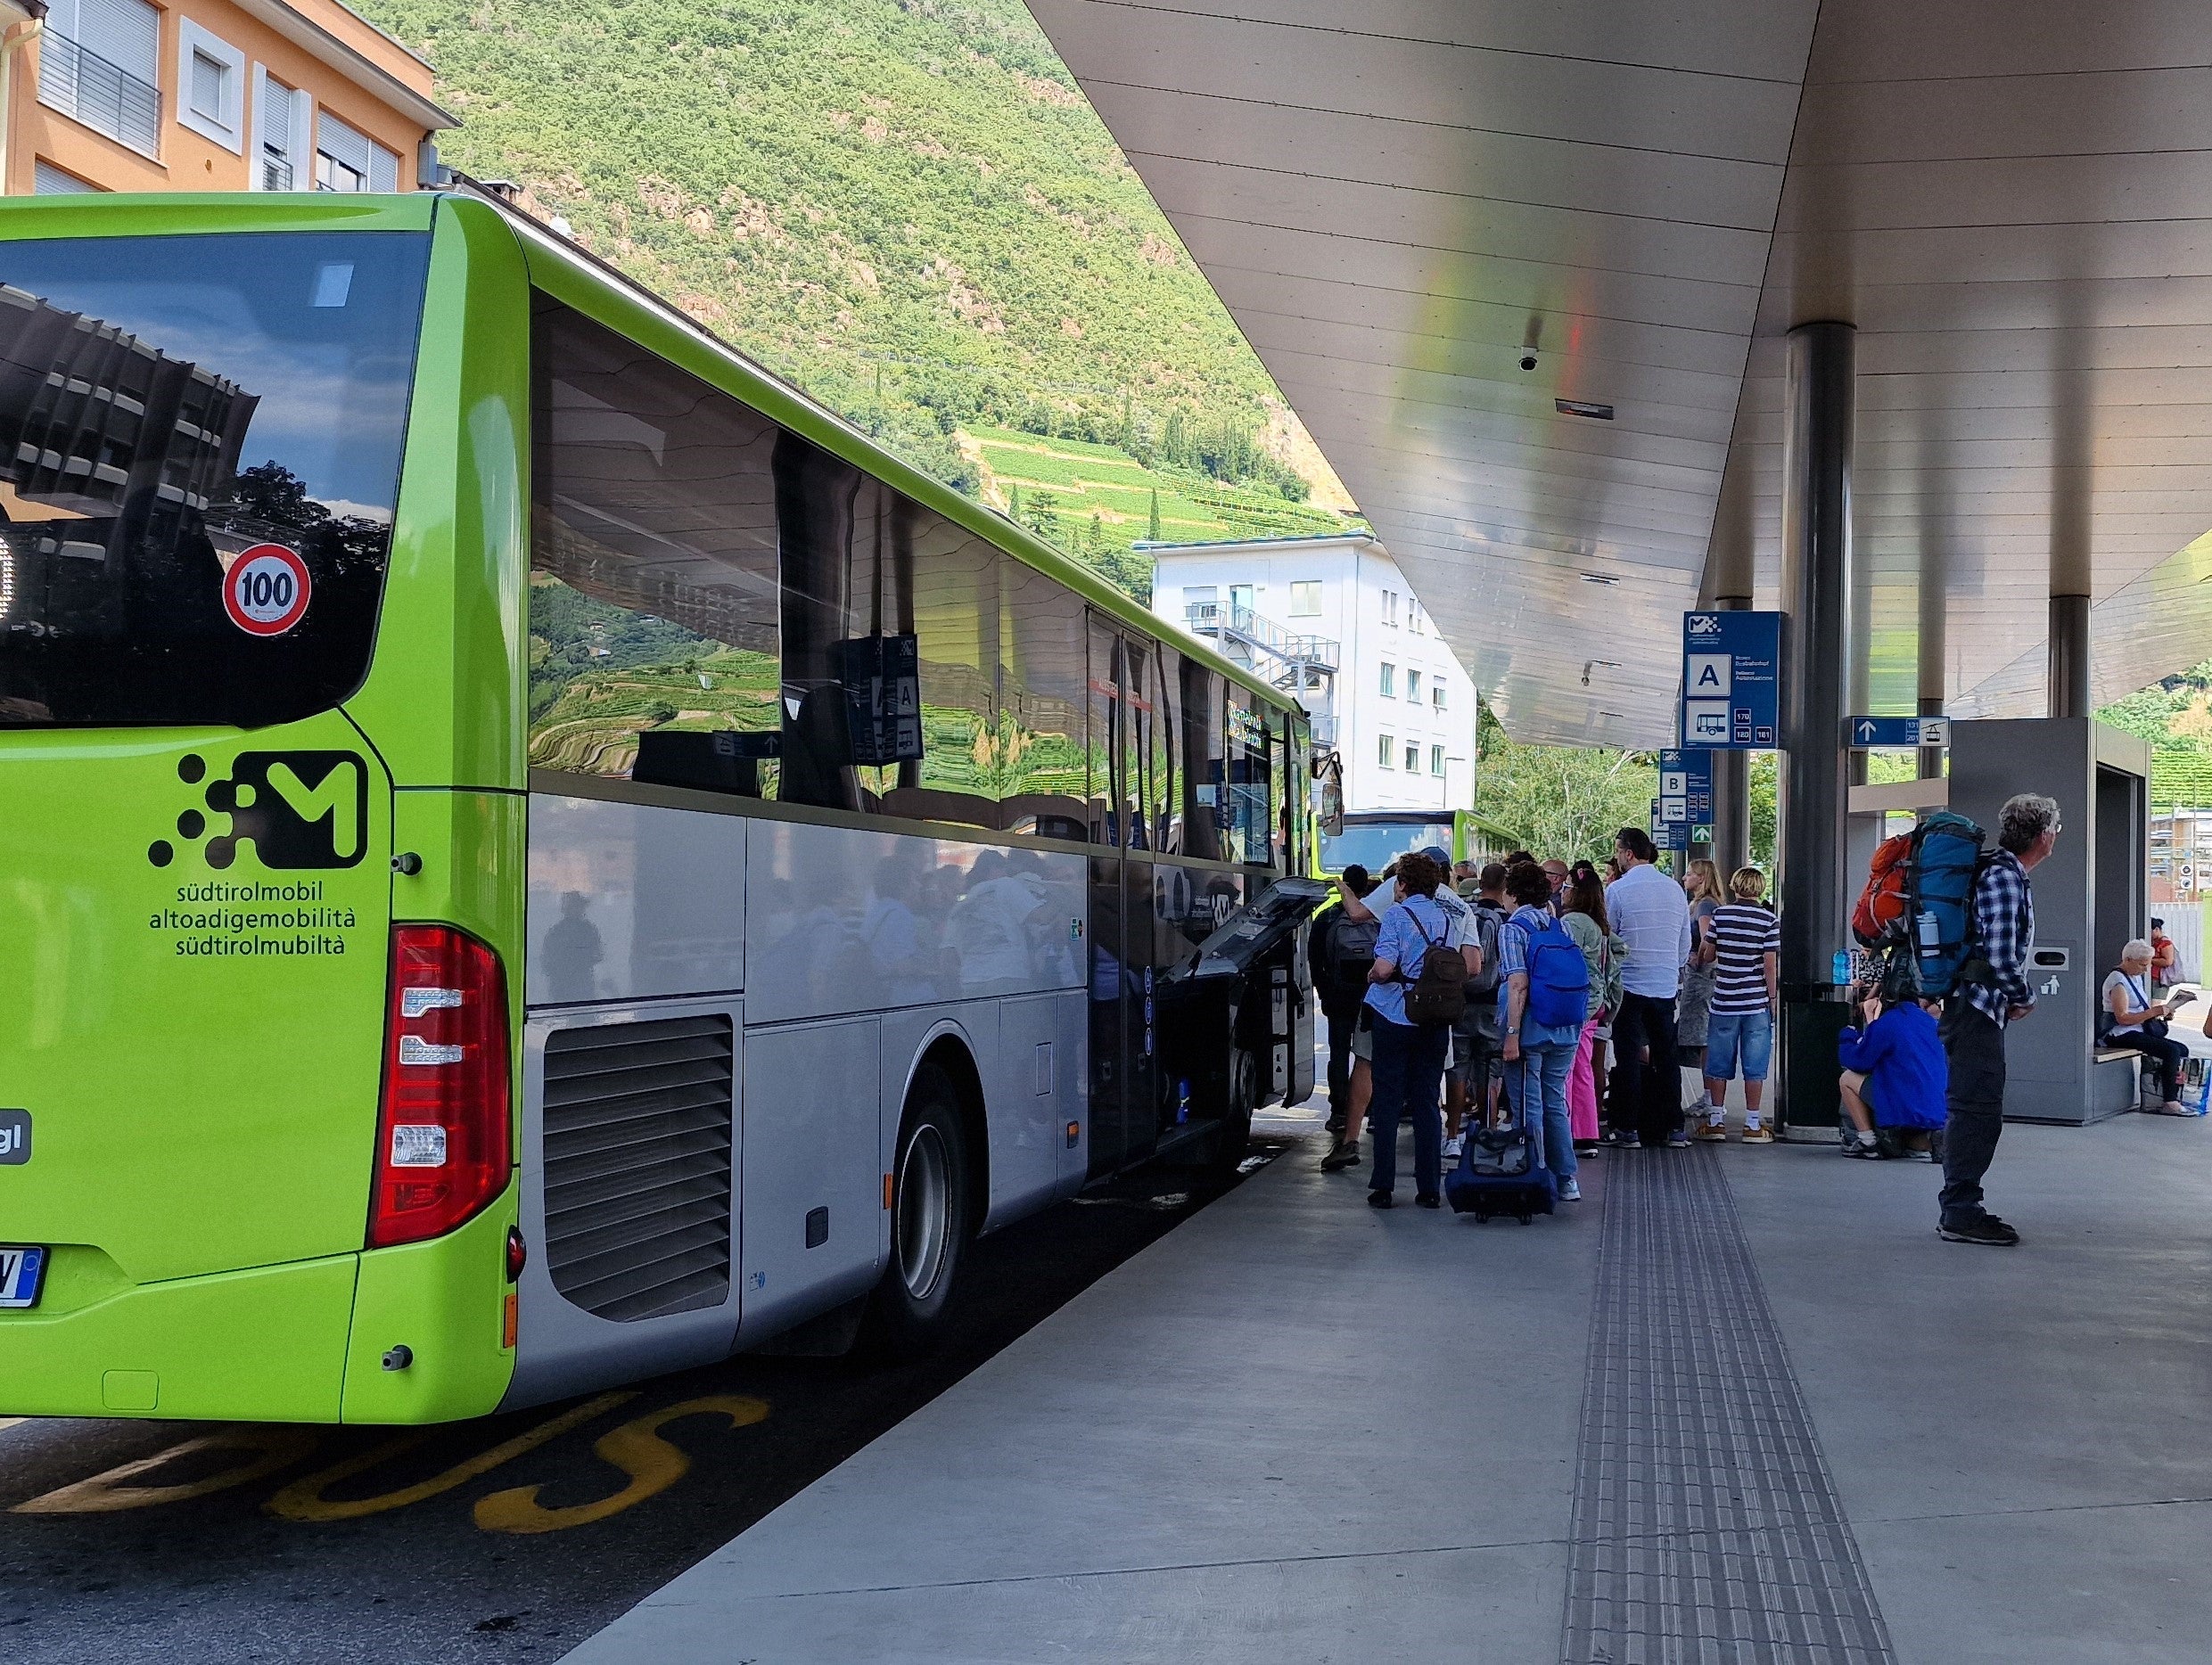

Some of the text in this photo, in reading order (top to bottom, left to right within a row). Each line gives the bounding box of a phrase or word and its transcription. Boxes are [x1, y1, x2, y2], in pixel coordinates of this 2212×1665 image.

[243, 571, 292, 607] 100
[1698, 665, 1719, 686] A
[1670, 778, 1678, 790] B
[177, 881, 323, 902] südtirolmobil
[149, 907, 356, 934] altoadigemobilità
[176, 934, 345, 956] südtirolmubiltà
